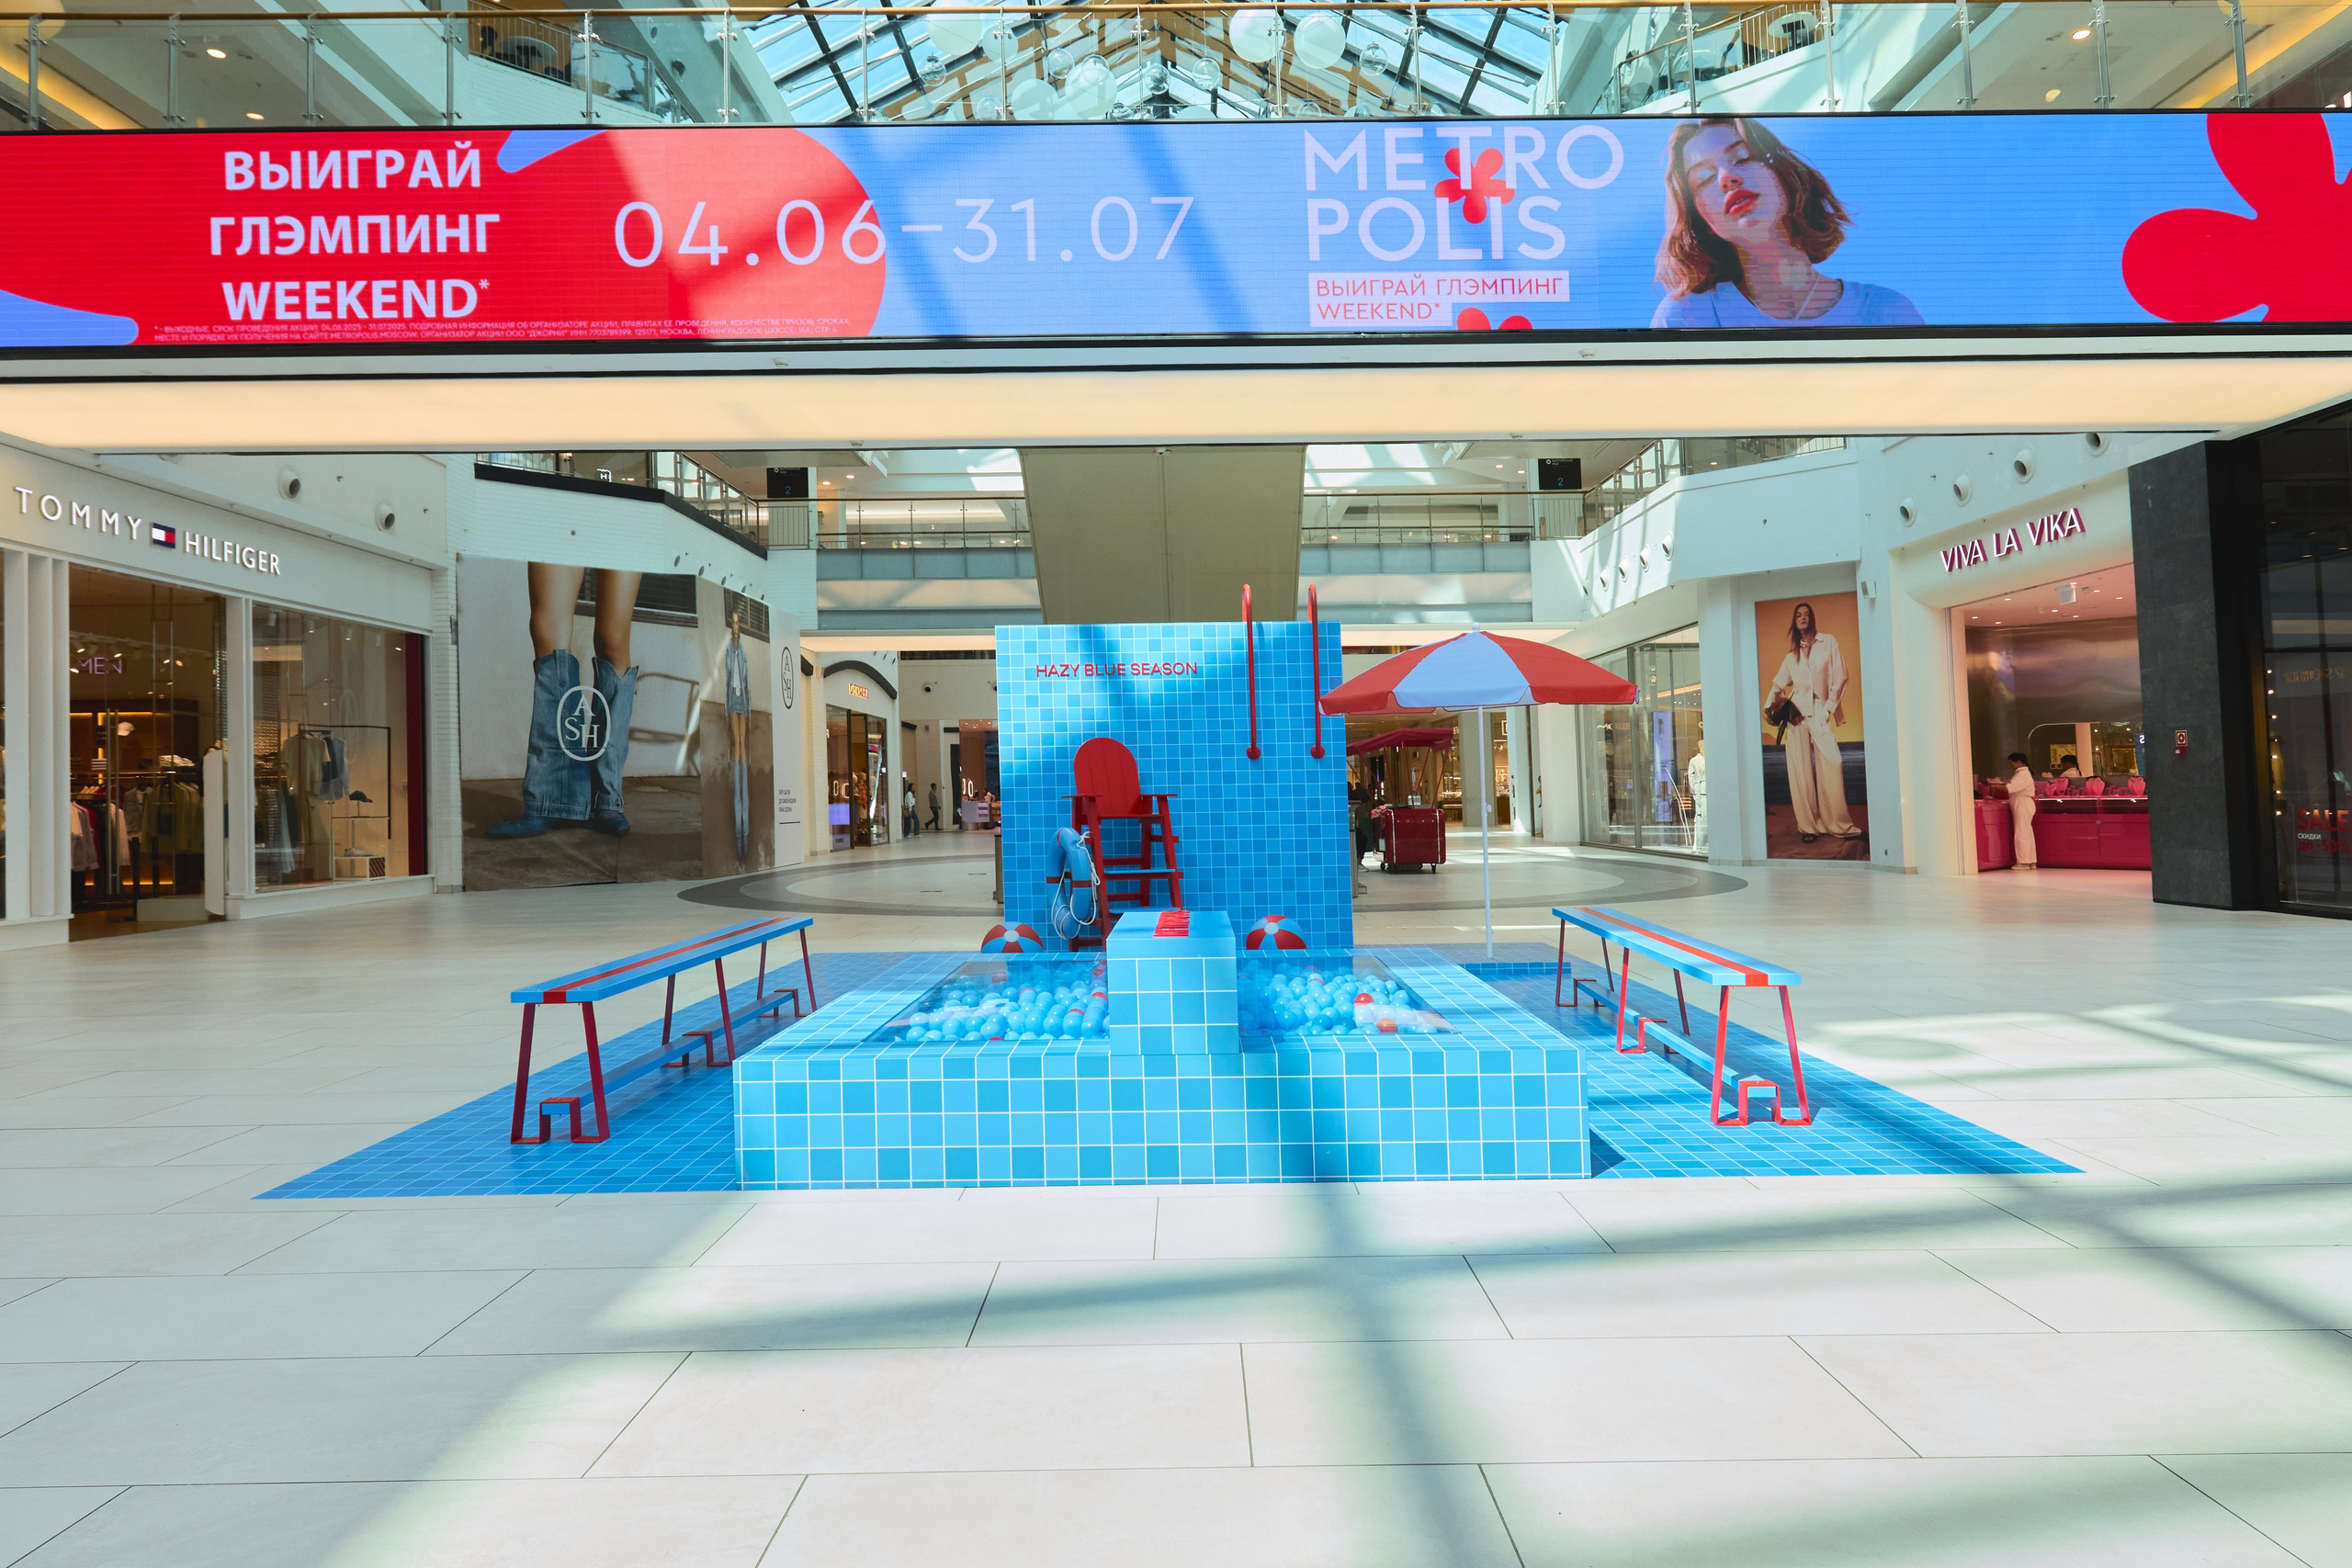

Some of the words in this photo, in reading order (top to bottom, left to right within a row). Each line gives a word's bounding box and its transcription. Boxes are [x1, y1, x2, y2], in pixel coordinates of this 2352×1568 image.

[224, 141, 481, 191] ВЫИГРАЙ
[1304, 125, 1624, 191] METRO
[209, 214, 500, 255] ГЛЭМПИНГ
[1306, 195, 1566, 262] POLIS
[1317, 274, 1425, 297] ВЫИГРАЙ
[1436, 277, 1564, 296] ГЛЭМПИНГ
[621, 320, 662, 328] ПРАВИЛАХ
[786, 485, 791, 494] 2
[1557, 477, 1564, 486] 2
[15, 487, 142, 540] TOMMY
[184, 531, 281, 576] HILFIGER
[1939, 539, 1988, 572] VIVA
[1992, 528, 2022, 558] LA
[2026, 507, 2086, 547] VIKA
[1035, 663, 1080, 678] HAZY
[1084, 663, 1126, 677] BLUE
[1130, 661, 1198, 676] SEASON
[2298, 809, 2350, 832] SALE
